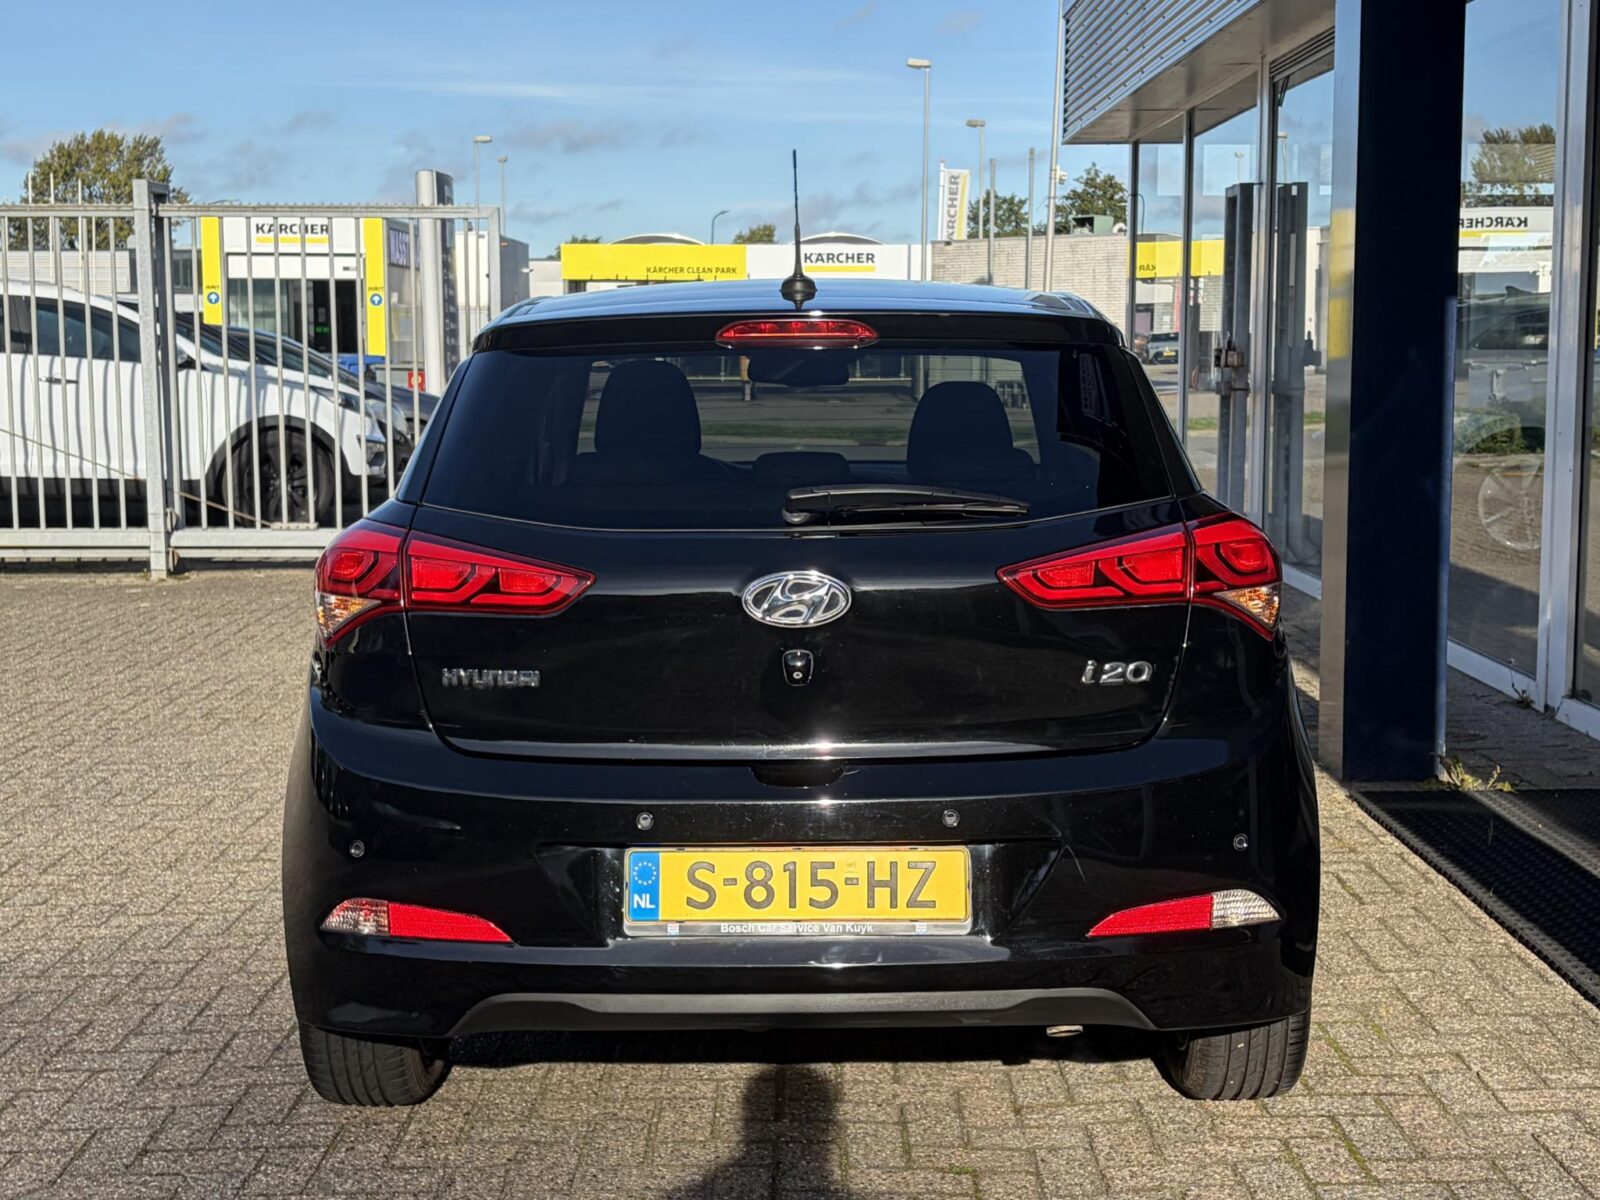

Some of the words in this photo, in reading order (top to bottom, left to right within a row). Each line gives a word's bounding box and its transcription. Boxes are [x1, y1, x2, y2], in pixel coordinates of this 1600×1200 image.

[804, 252, 875, 264] KÄRCHER
[646, 265, 685, 275] KÄRCHER
[686, 266, 713, 275] CLEAN
[715, 266, 737, 275] PARK
[442, 668, 540, 688] HYUNDAI
[1081, 660, 1153, 684] i20
[686, 861, 937, 909] S-815-HZ
[633, 894, 656, 909] NL
[720, 923, 755, 933] Bosch
[758, 923, 776, 933] Car
[781, 923, 819, 933] Service
[823, 923, 843, 933] Van
[845, 923, 874, 935] Kuyk
